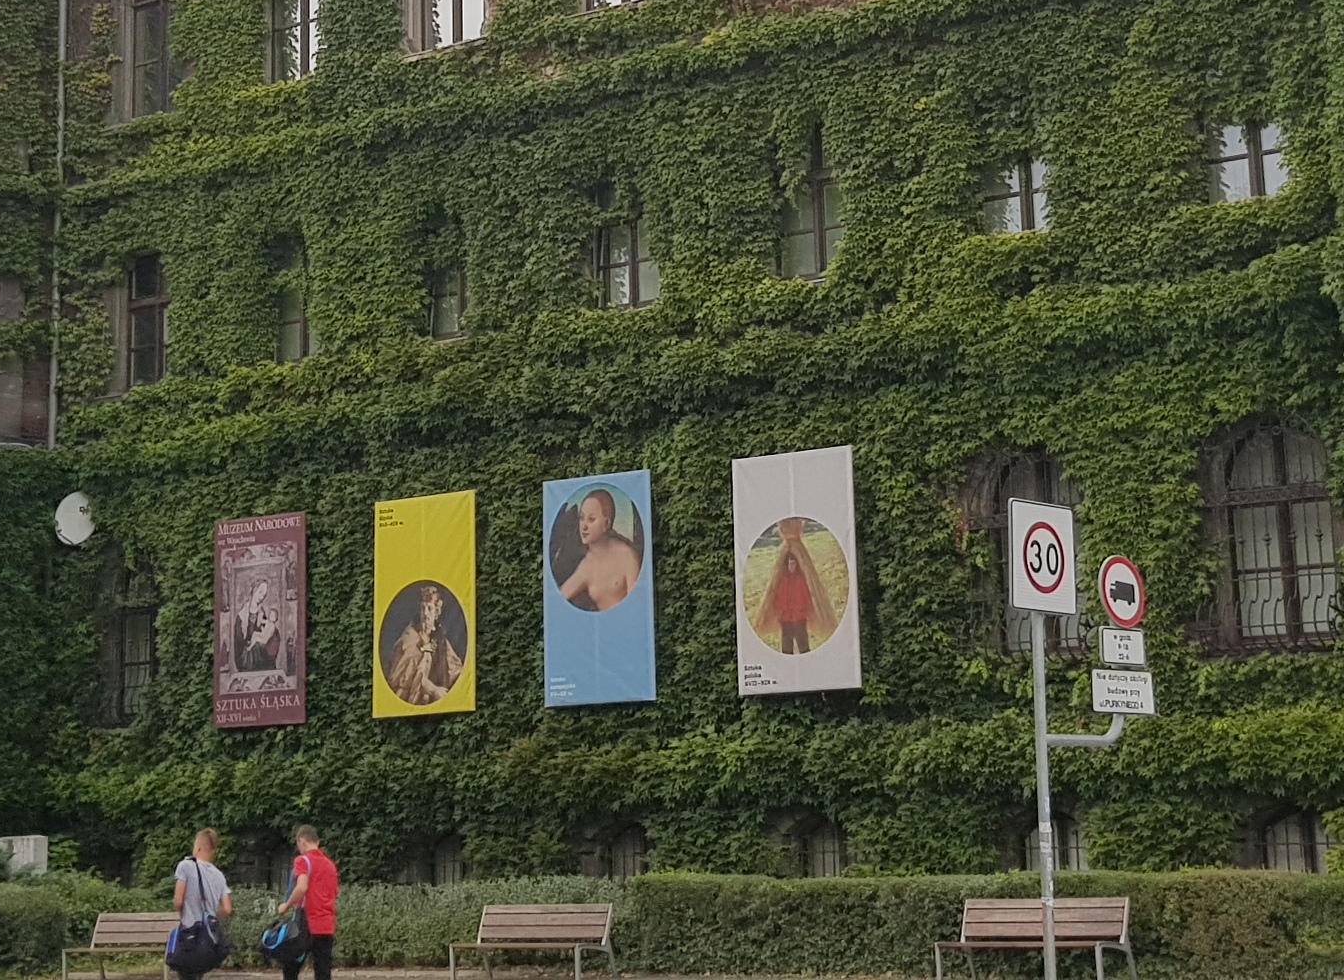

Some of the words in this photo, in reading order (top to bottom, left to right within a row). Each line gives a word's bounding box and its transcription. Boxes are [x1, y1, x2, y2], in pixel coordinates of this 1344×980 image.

[218, 522, 254, 535] MUZEUM
[255, 516, 301, 531] NARODOWE
[1029, 540, 1059, 576] 30
[216, 698, 257, 711] SZTUKA
[260, 694, 300, 710] ŚLĄSKA
